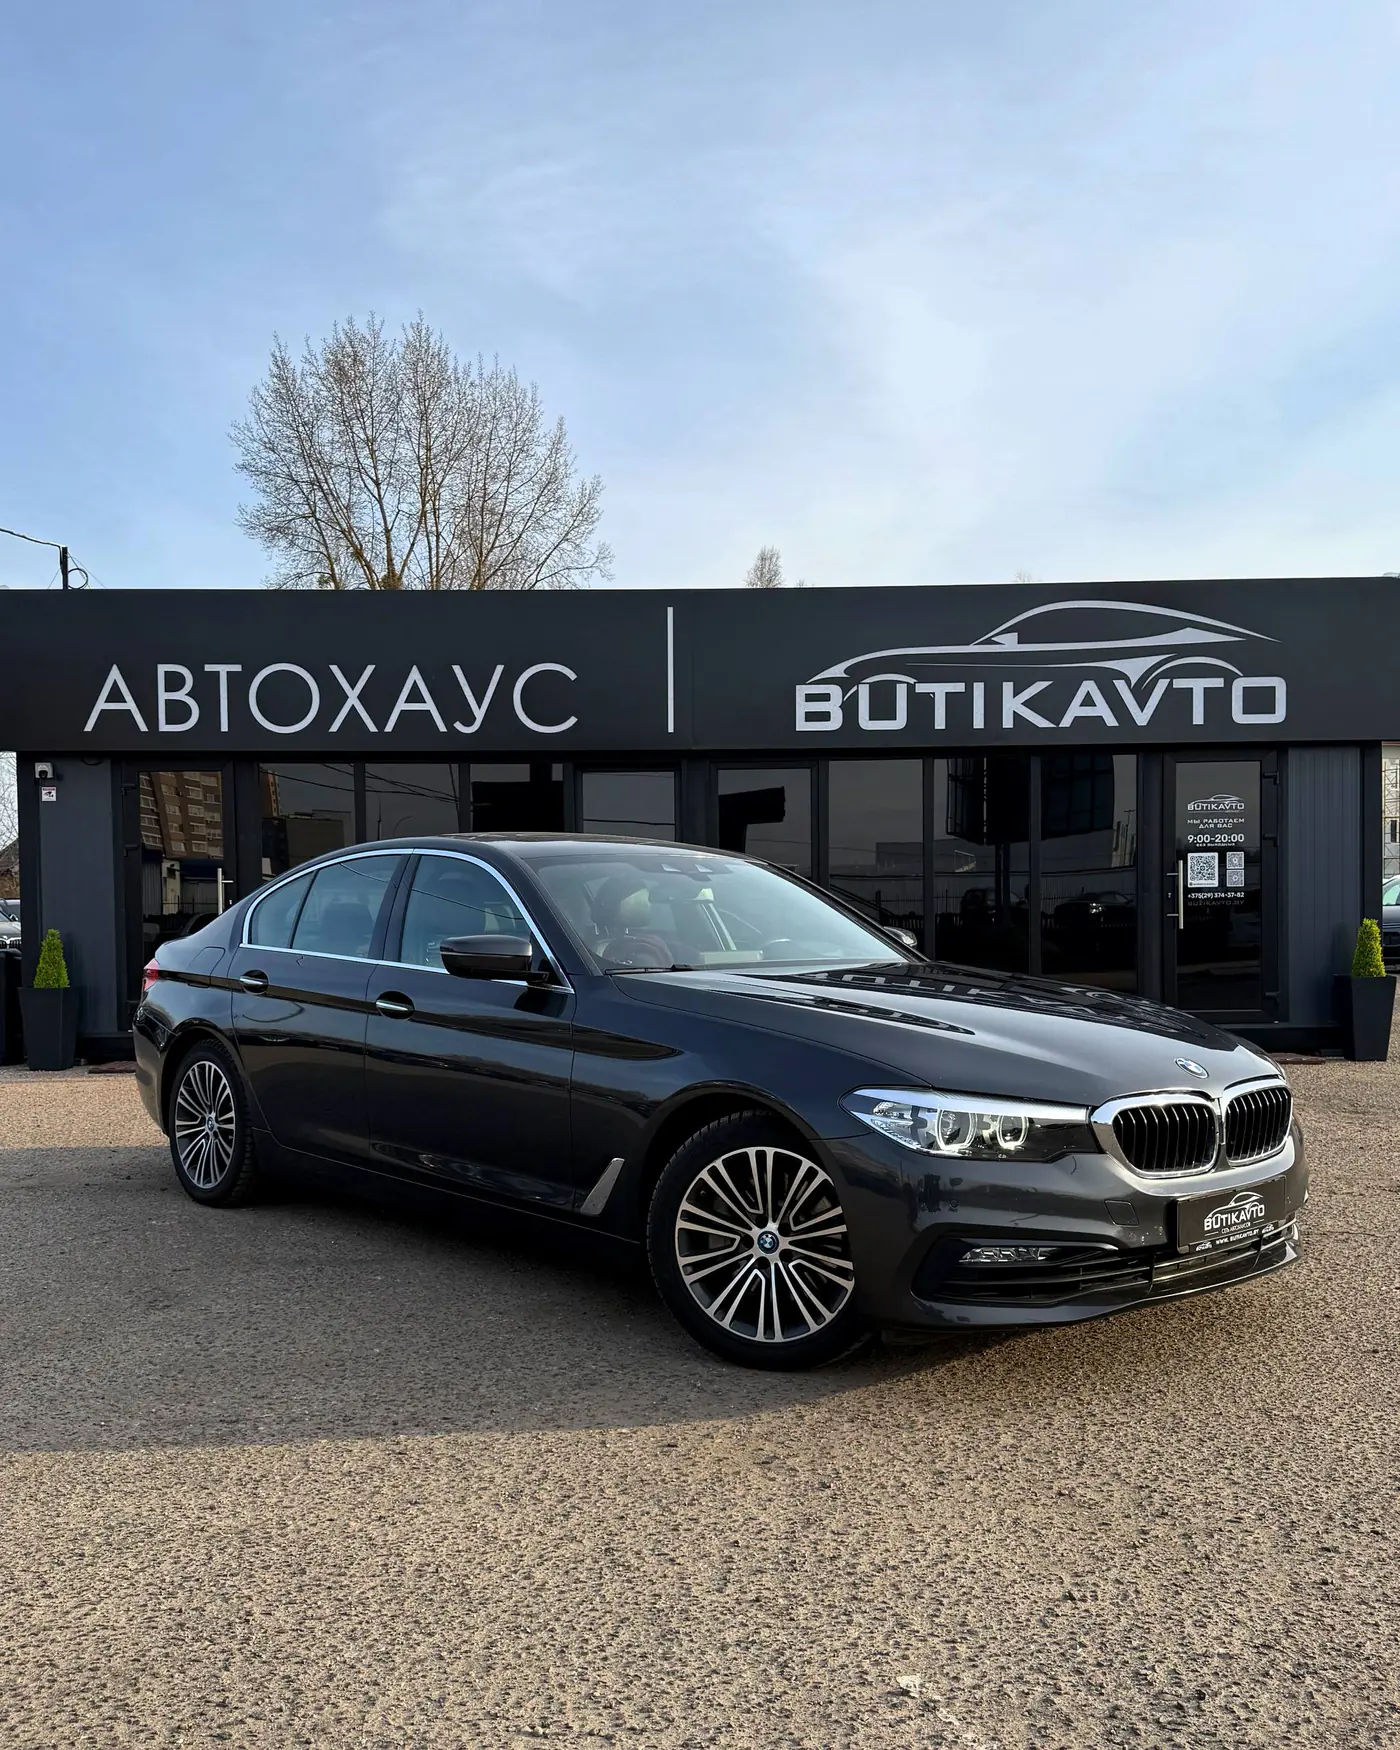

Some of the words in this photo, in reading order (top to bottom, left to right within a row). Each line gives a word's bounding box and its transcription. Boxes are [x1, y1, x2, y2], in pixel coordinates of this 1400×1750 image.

[83, 662, 579, 735] АВТОХАУС
[795, 676, 1287, 732] BUTIKAVTO
[1187, 802, 1245, 811] BUTIKAVTO
[1187, 833, 1245, 843] 9:00-20:00
[1203, 1204, 1265, 1231] BUTIKAVTO
